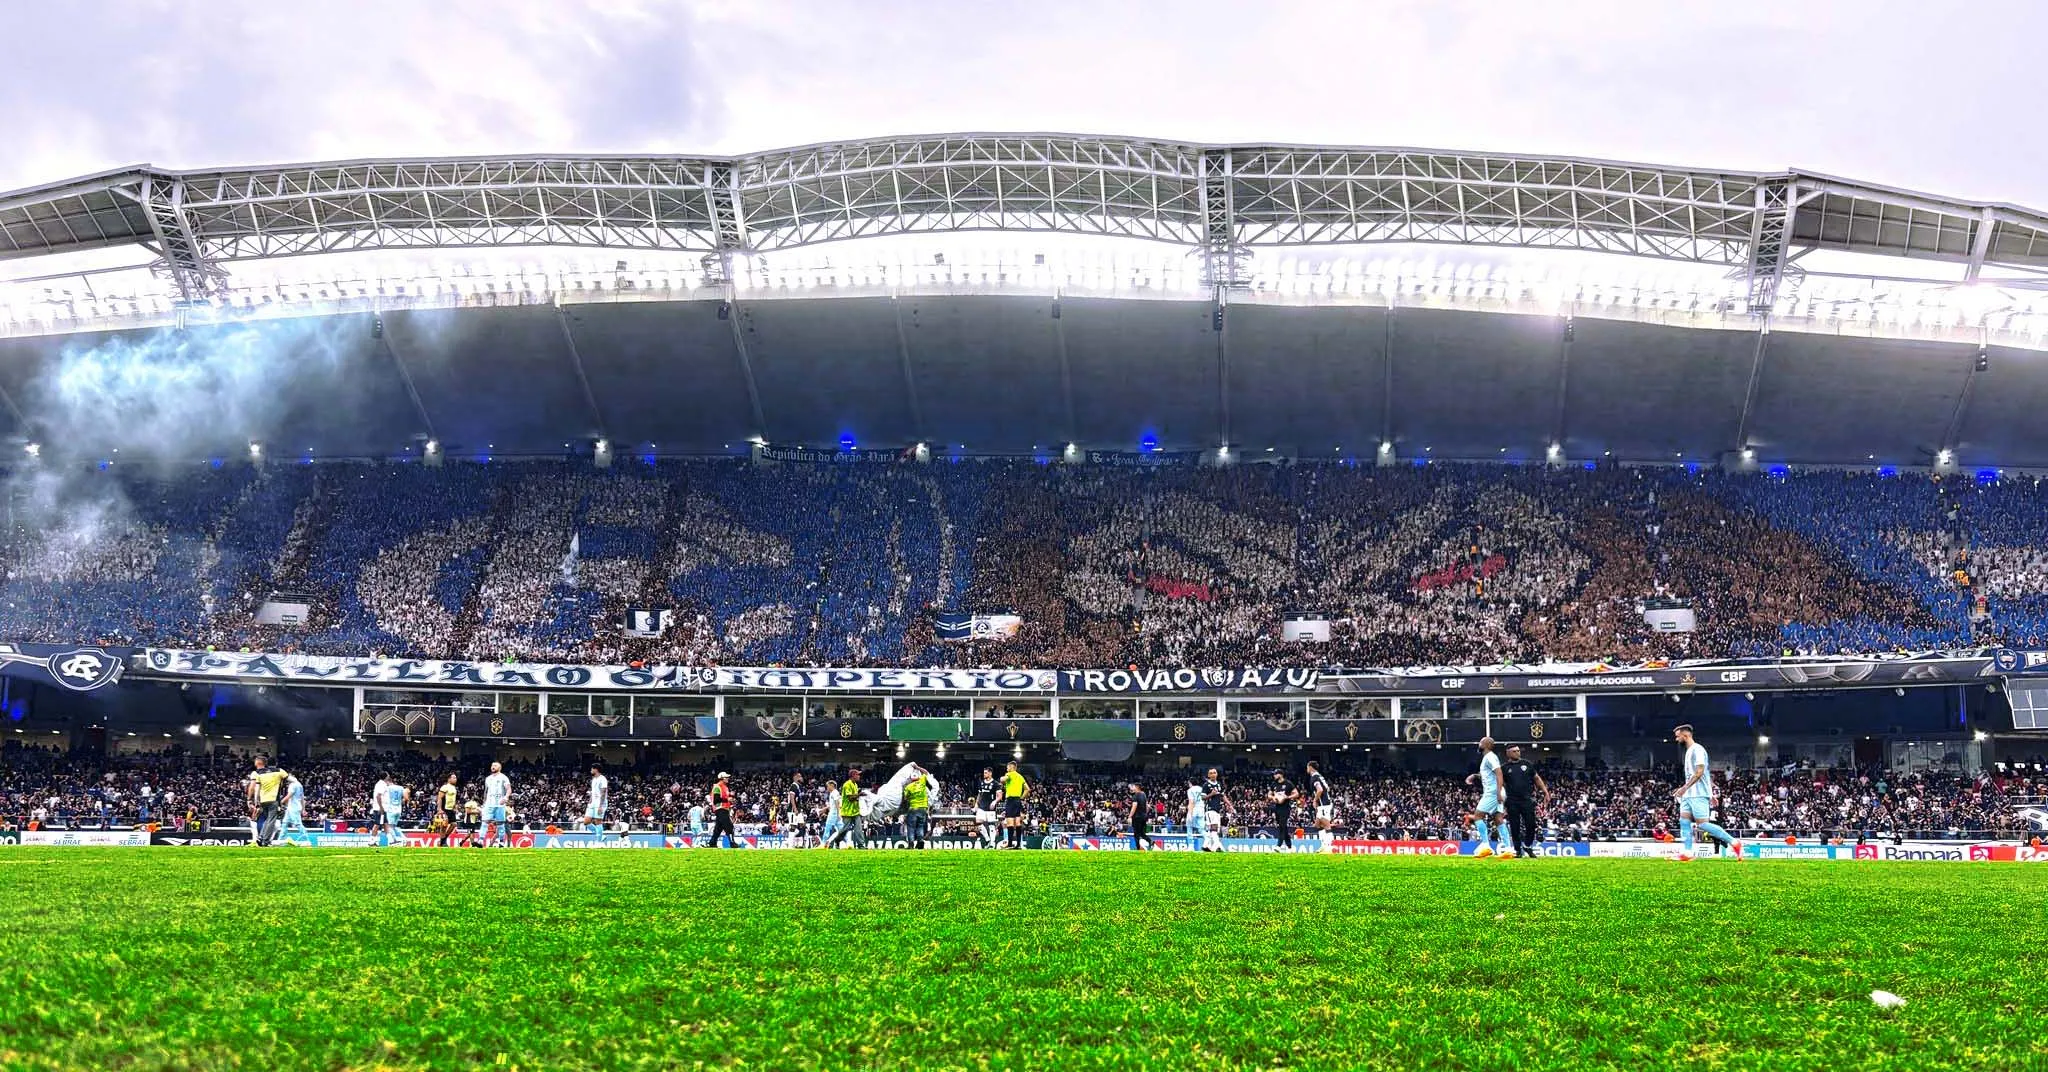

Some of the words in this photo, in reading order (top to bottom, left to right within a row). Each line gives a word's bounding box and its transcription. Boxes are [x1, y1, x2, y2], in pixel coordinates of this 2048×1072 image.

[818, 451, 831, 462] do
[1721, 671, 1747, 682] CBF
[1441, 678, 1465, 688] CBF
